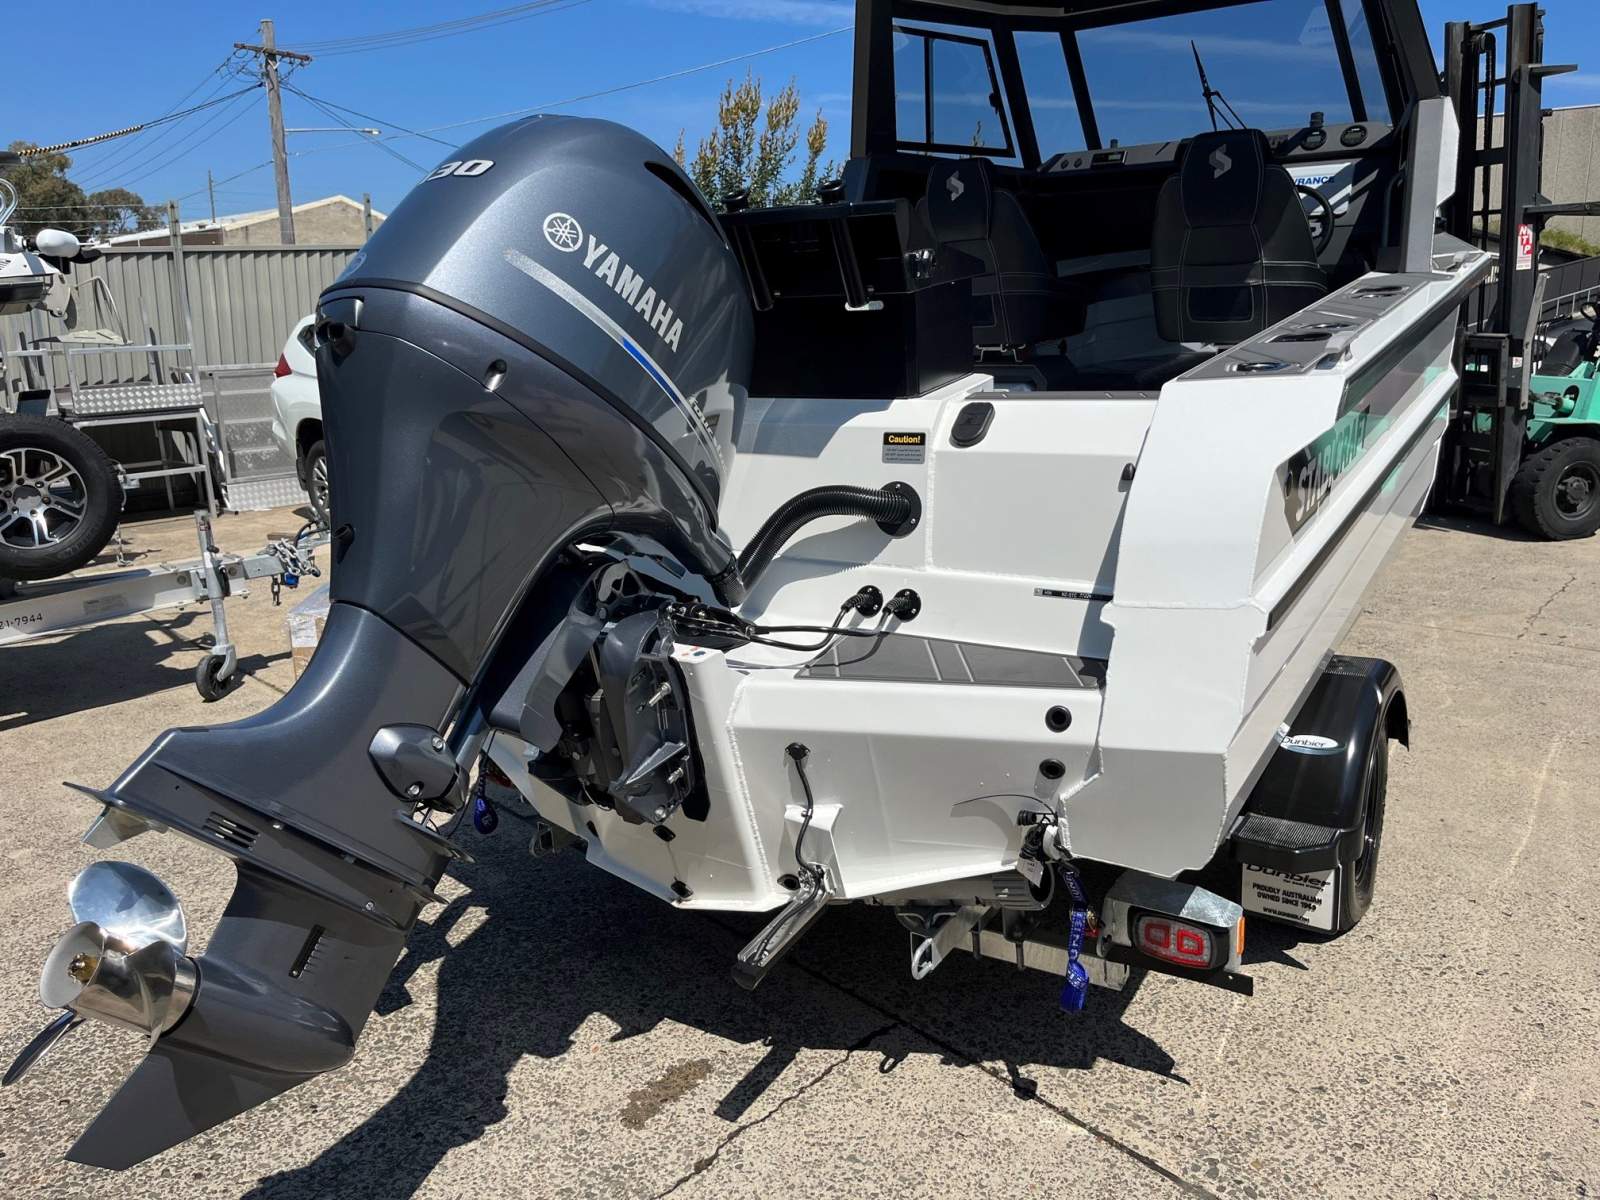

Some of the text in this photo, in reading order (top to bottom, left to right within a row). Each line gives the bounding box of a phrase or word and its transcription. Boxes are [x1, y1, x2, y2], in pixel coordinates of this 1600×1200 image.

[1296, 176, 1335, 186] RANCE
[582, 234, 685, 353] YAMAHA
[888, 434, 921, 444] Caution!
[1252, 882, 1281, 895] PROUDLY
[1282, 889, 1323, 905] AUSTRALIAN
[1257, 891, 1280, 903] OWNED
[1281, 896, 1299, 907] SINCE
